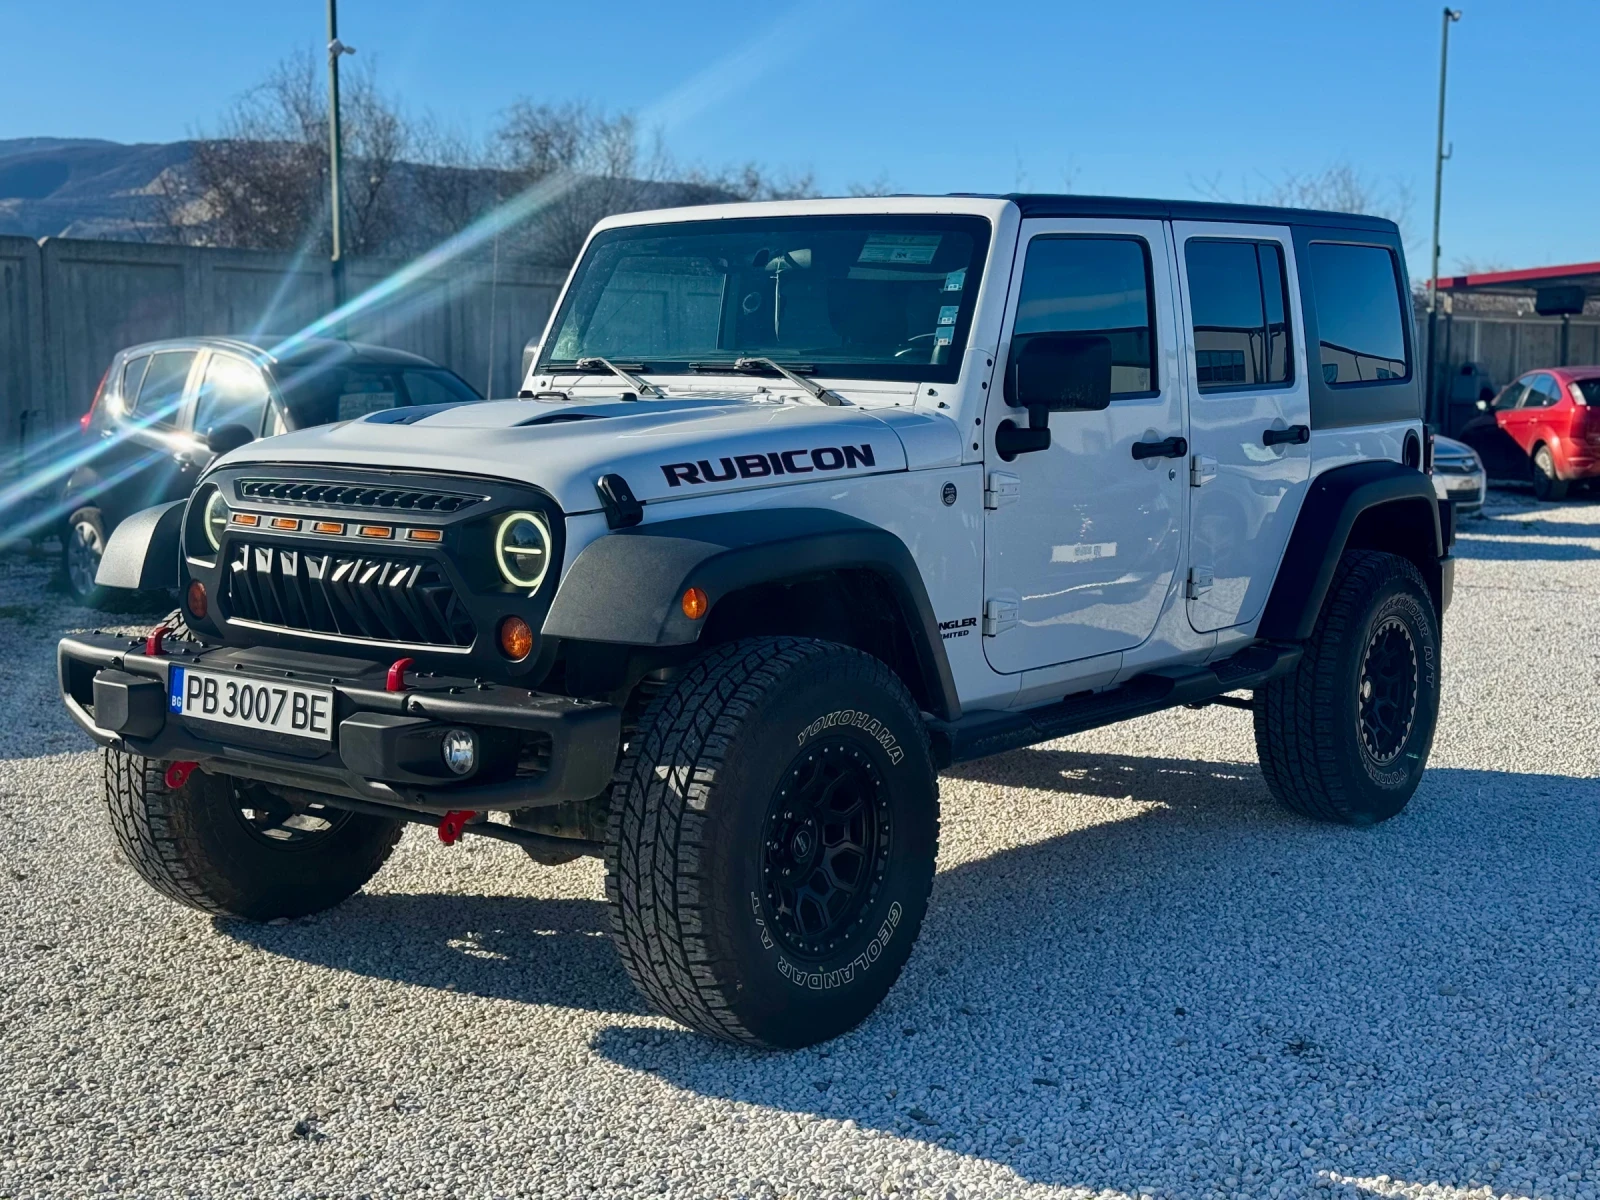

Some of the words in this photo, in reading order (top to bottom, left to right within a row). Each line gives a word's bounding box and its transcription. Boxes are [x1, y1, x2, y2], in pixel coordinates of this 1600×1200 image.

[660, 444, 876, 487] RUBICON
[171, 695, 182, 707] BG
[186, 675, 220, 714] PB
[223, 681, 289, 726] 3007
[291, 691, 328, 734] BE
[797, 710, 904, 765] YOKOHAMA
[751, 891, 774, 949] A/T
[777, 901, 903, 990] GEOLANDAR
